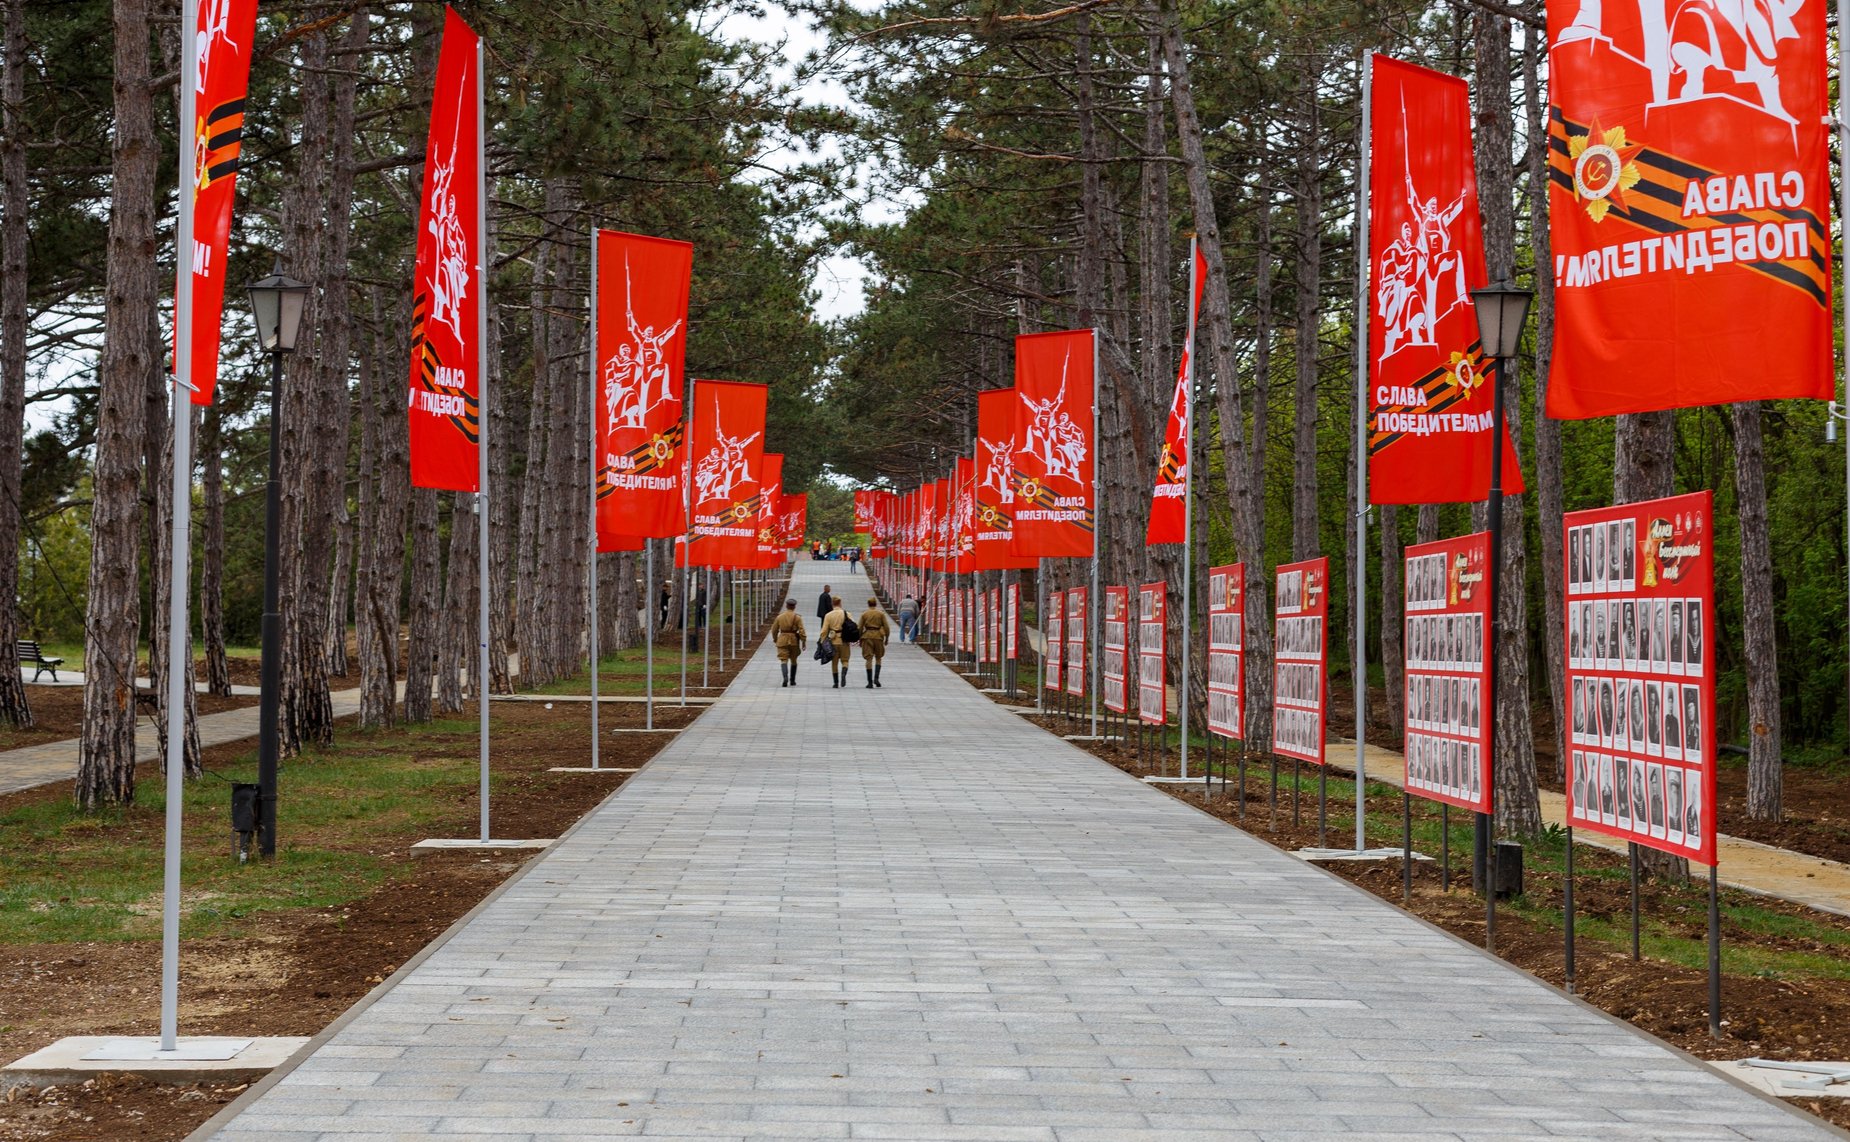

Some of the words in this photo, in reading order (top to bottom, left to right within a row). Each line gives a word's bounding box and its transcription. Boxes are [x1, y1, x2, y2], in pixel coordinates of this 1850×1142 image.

[1377, 385, 1428, 406] СЛАВА
[694, 515, 721, 525] СЛАВА
[694, 526, 755, 537] ПОБЕДИТЕЛЯМ!
